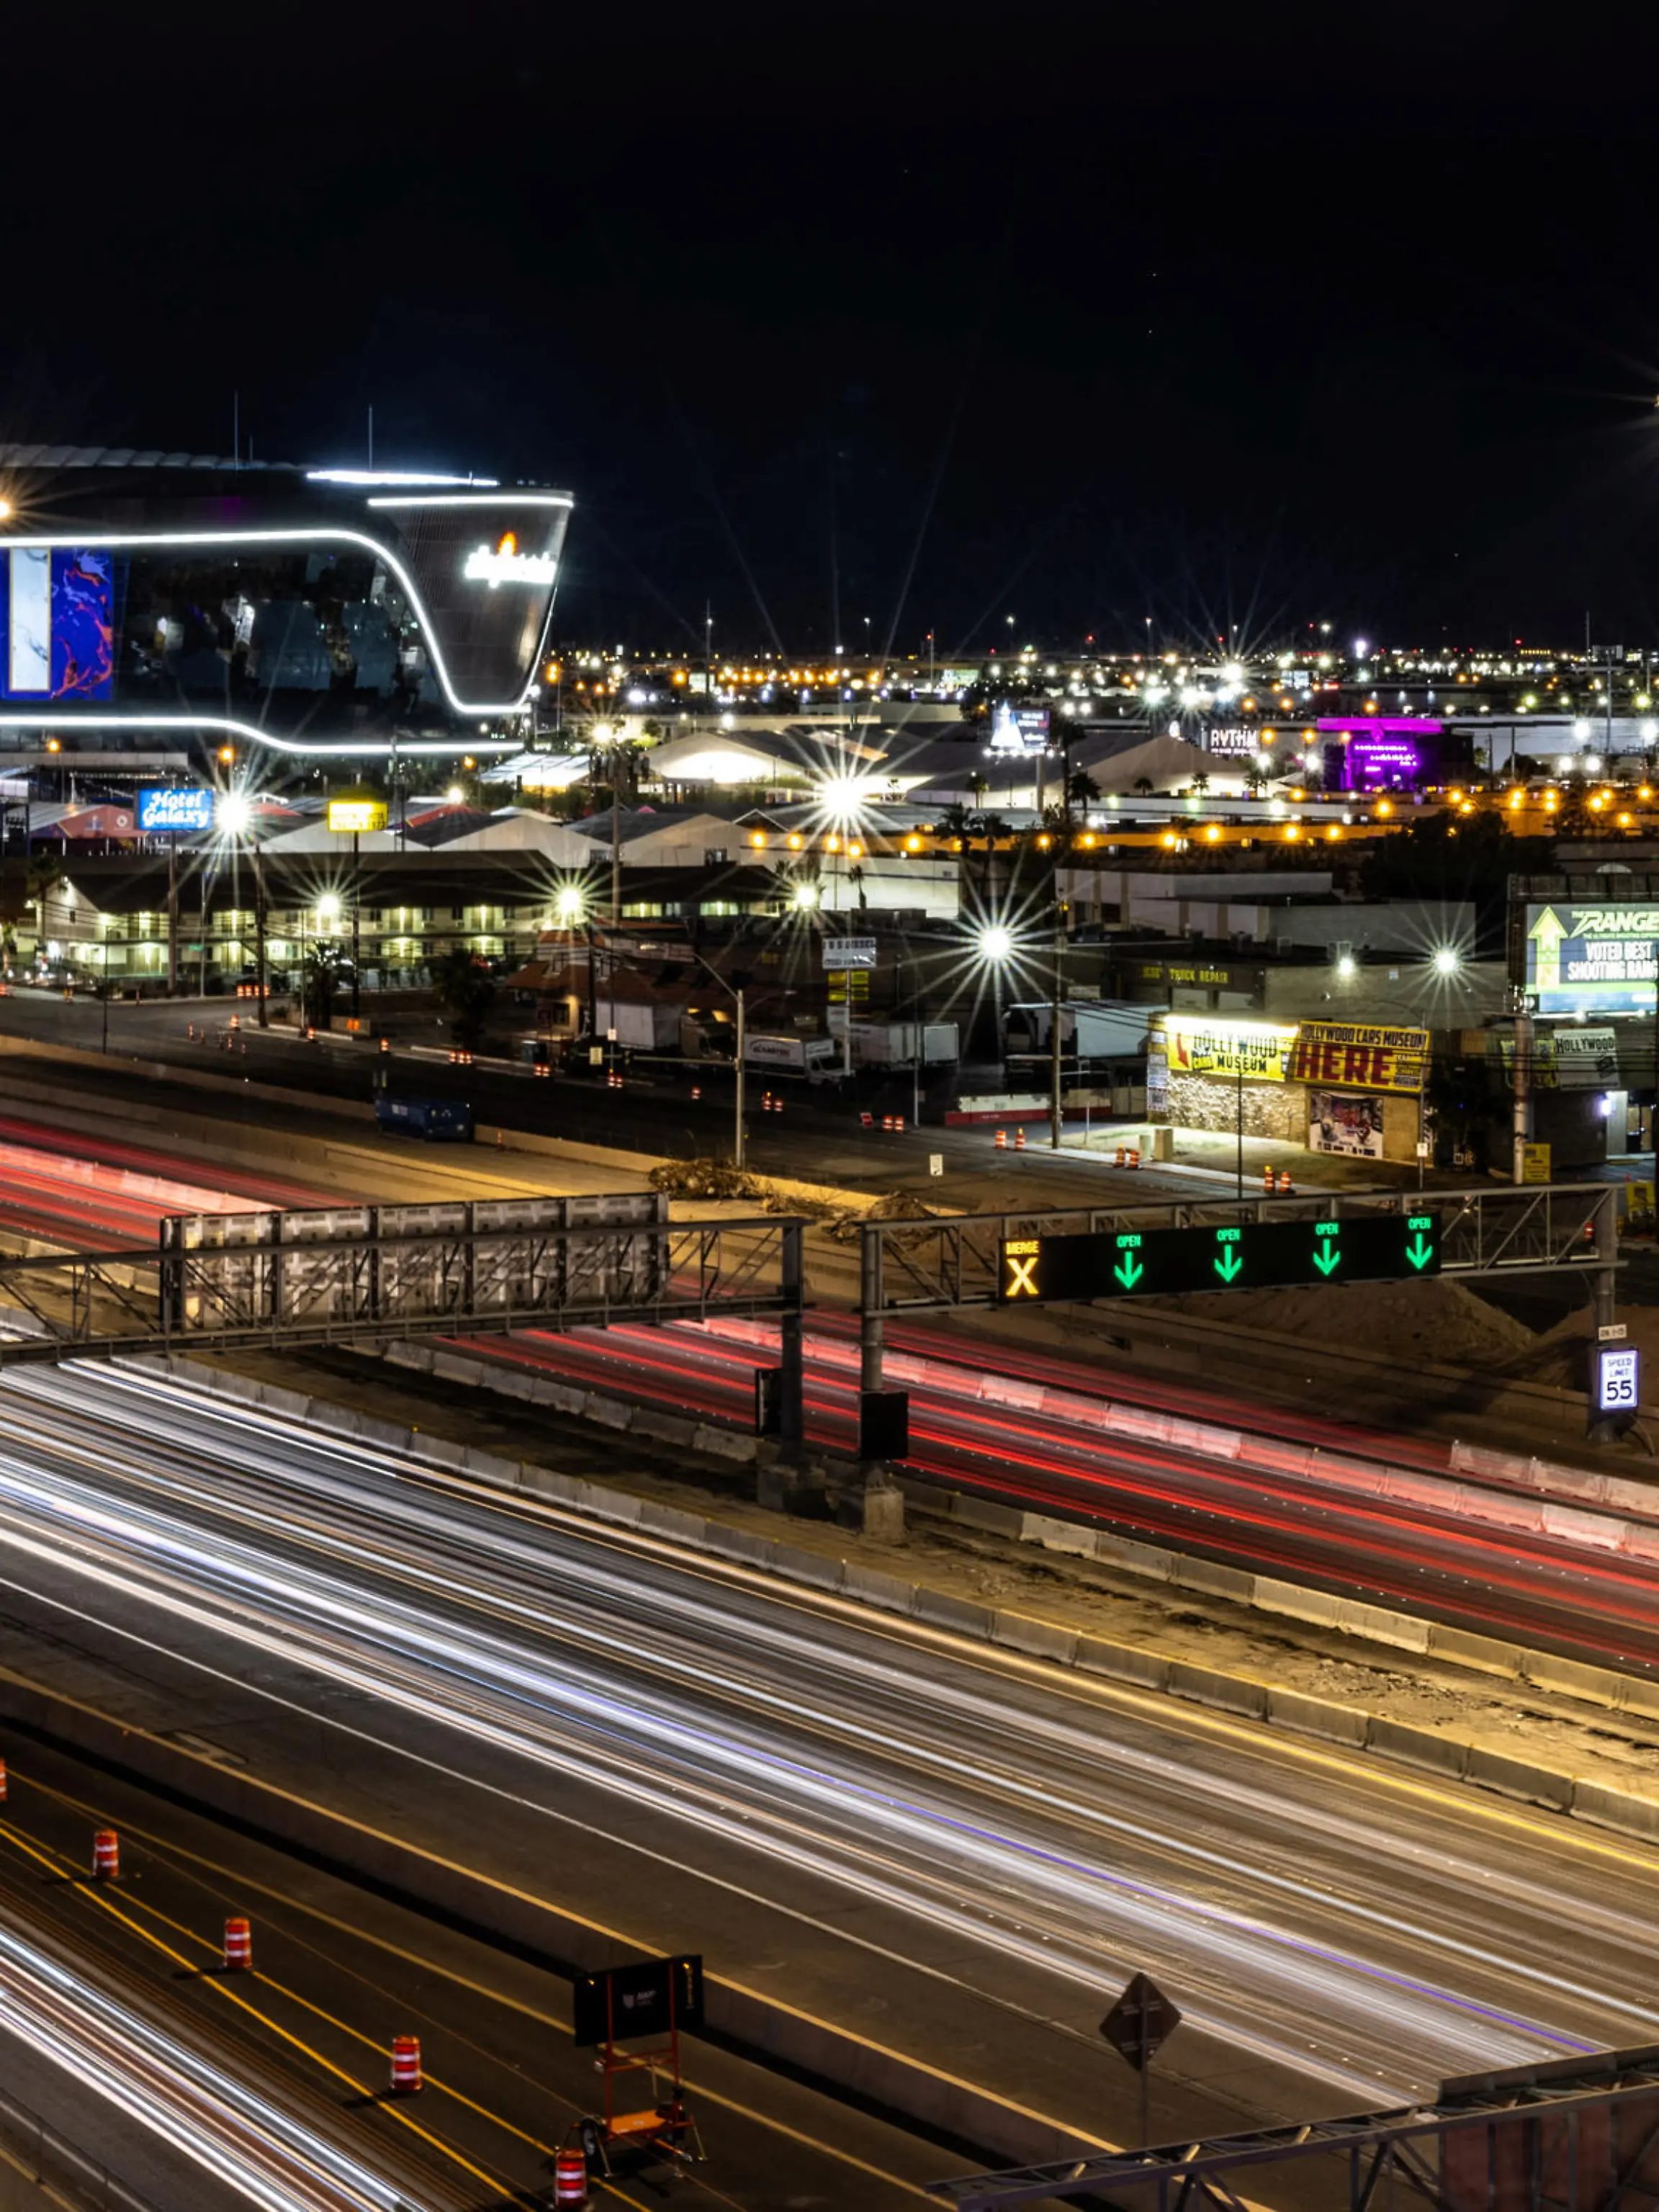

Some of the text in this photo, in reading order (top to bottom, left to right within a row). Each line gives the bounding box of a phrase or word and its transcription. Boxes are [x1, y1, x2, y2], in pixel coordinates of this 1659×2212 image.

[149, 791, 206, 808] Hotel
[143, 808, 209, 828] Galaxy
[1586, 941, 1653, 961] VOTED BEST
[1199, 970, 1228, 984] REPAIR
[1568, 961, 1658, 981] SHOOTING RANG
[1357, 1029, 1382, 1046] CARS
[1382, 1030, 1424, 1048] MUSEUM
[1555, 1036, 1614, 1053] HOLLYWOOD
[1218, 1054, 1267, 1072] MUSEUM
[1297, 1043, 1394, 1085] HERE
[1315, 1223, 1339, 1236] OPEN
[1408, 1217, 1432, 1230] OPEN
[1116, 1234, 1141, 1248] OPEN
[1217, 1228, 1241, 1241] OPEN
[1006, 1240, 1039, 1255] MERGE
[1608, 1357, 1632, 1367] SPEED
[1606, 1380, 1632, 1401] 55
